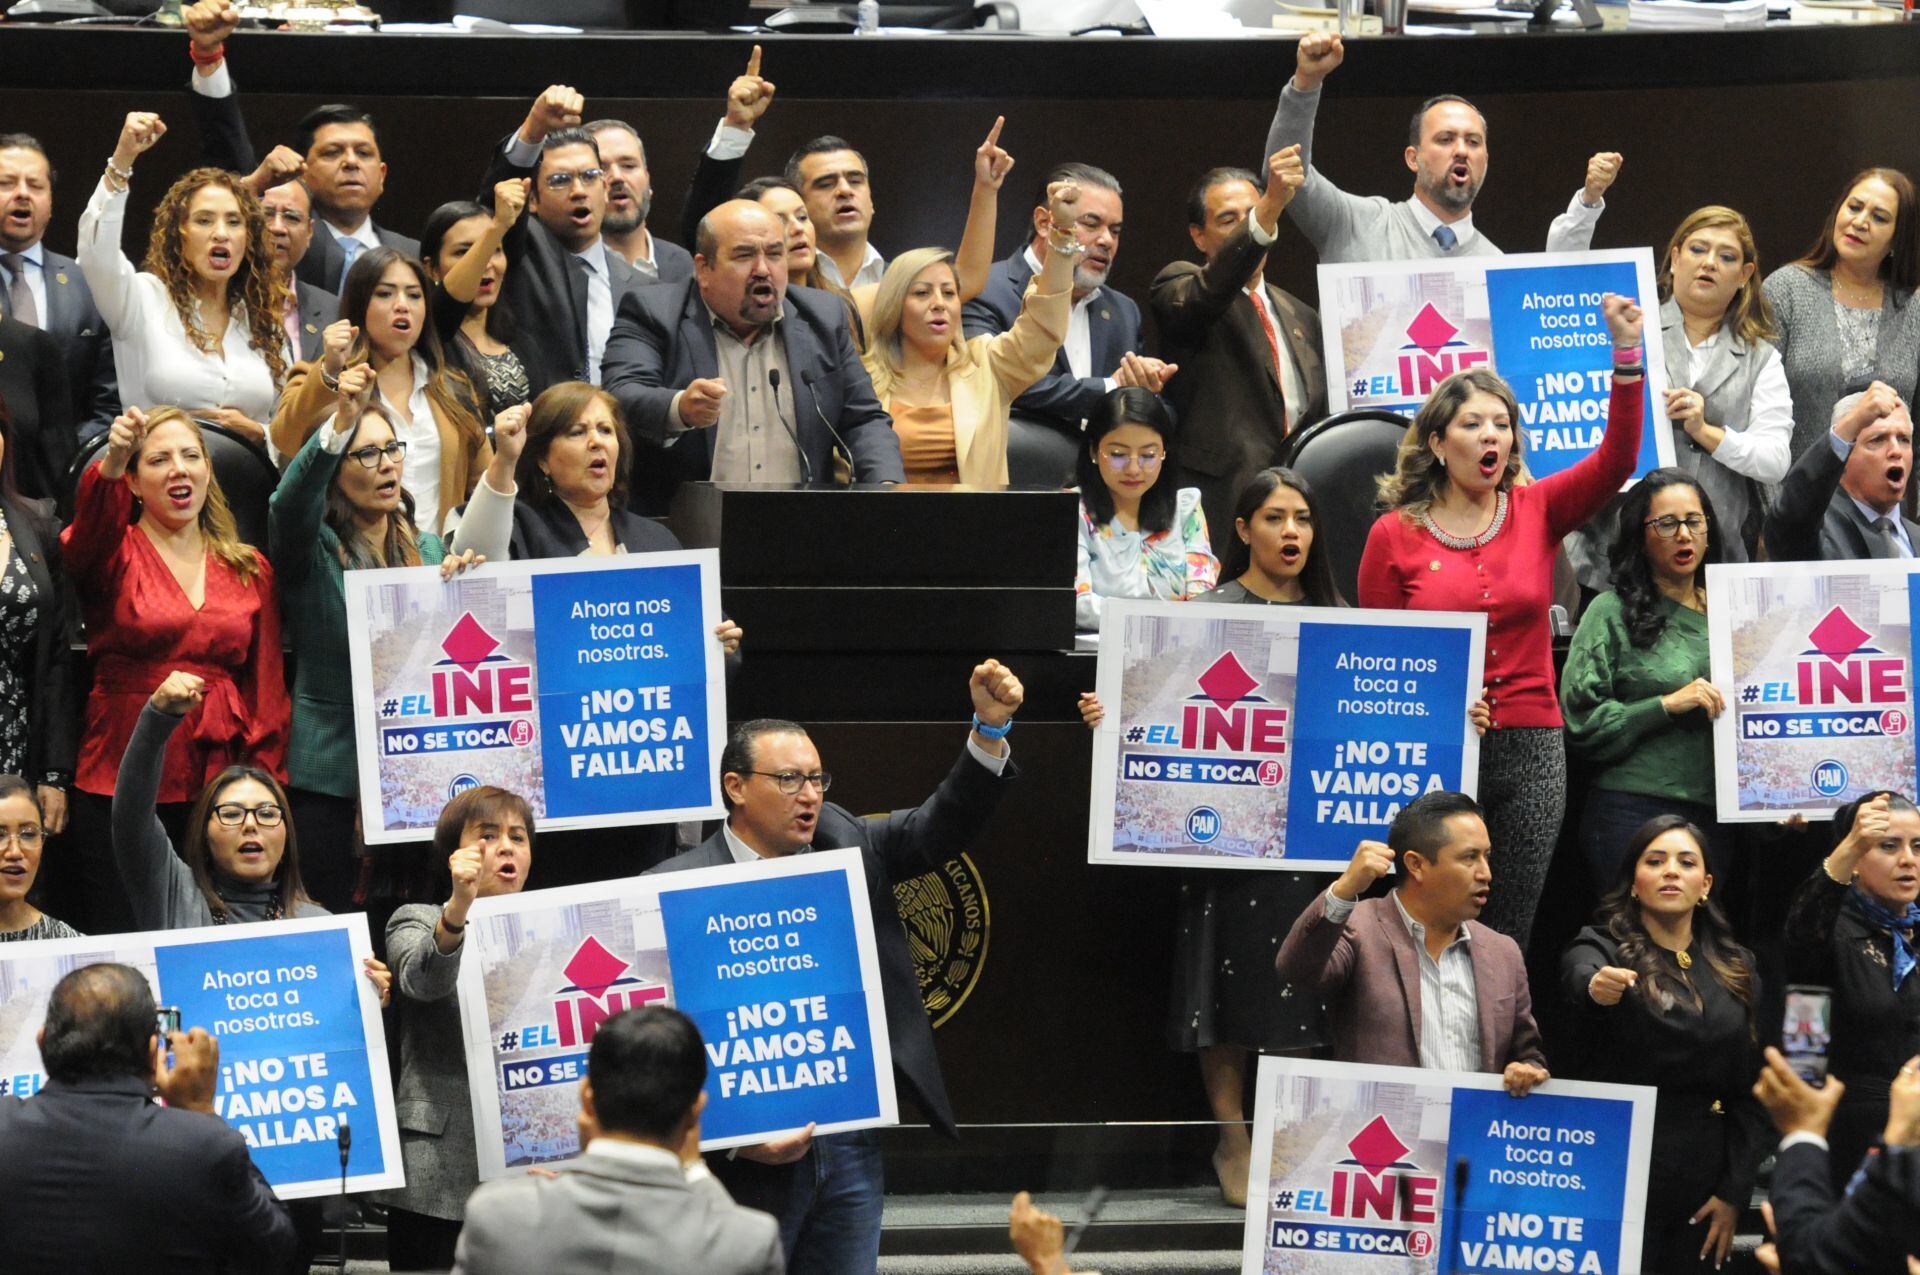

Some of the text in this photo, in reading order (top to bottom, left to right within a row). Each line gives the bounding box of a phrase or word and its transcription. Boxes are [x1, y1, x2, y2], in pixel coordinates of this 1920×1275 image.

[1522, 293, 1574, 310] Ahora
[1540, 314, 1596, 329] toca a
[1530, 331, 1612, 350] nosotros.
[1536, 372, 1584, 400] ¡NO
[1518, 398, 1609, 424] VAMOS
[1530, 426, 1604, 451] FALLA
[570, 598, 671, 619] Ahora nos
[590, 621, 654, 641] toca a
[578, 643, 669, 663] nosotras.
[1335, 653, 1437, 673] Ahora nos
[1353, 675, 1417, 694] toca a
[580, 686, 671, 721] ¡NO TE
[1337, 697, 1430, 717] nosotras.
[560, 716, 693, 748] VAMOS A
[1747, 716, 1880, 736] NO SE TOCA
[387, 728, 510, 752] NO SE TOCA
[570, 745, 685, 779] FALLAR!
[1334, 741, 1427, 769] ¡NO TE
[1128, 761, 1258, 783] NO SE TOCA
[1310, 770, 1444, 796] VAMOS A
[1818, 769, 1841, 788] PAN
[1192, 815, 1214, 834] PAN
[1317, 800, 1401, 825] FALLA
[945, 860, 981, 929] ICANOS
[706, 906, 817, 935] Ahora nos
[729, 933, 800, 955] toca a
[202, 964, 318, 991] Ahora nos
[717, 953, 819, 980] nosotras.
[226, 989, 299, 1011] toca a
[213, 1009, 320, 1035] nosotras.
[726, 996, 828, 1039] ¡NO TE
[706, 1025, 855, 1068] VAMOS A
[222, 1053, 328, 1092] ¡NO TE
[508, 1066, 544, 1087] NO
[549, 1061, 578, 1081] SE
[719, 1056, 848, 1098] FALLAR!
[332, 1082, 358, 1108] A
[239, 1112, 347, 1148] ALLAR!
[1487, 1120, 1596, 1146] Ahora nos
[1506, 1143, 1573, 1167] toca a
[1489, 1166, 1586, 1191] nosotros.
[1486, 1212, 1584, 1242] ¡NO TE
[1276, 1227, 1406, 1254] NO SE TOCA
[1461, 1241, 1603, 1275] VAMOS A
